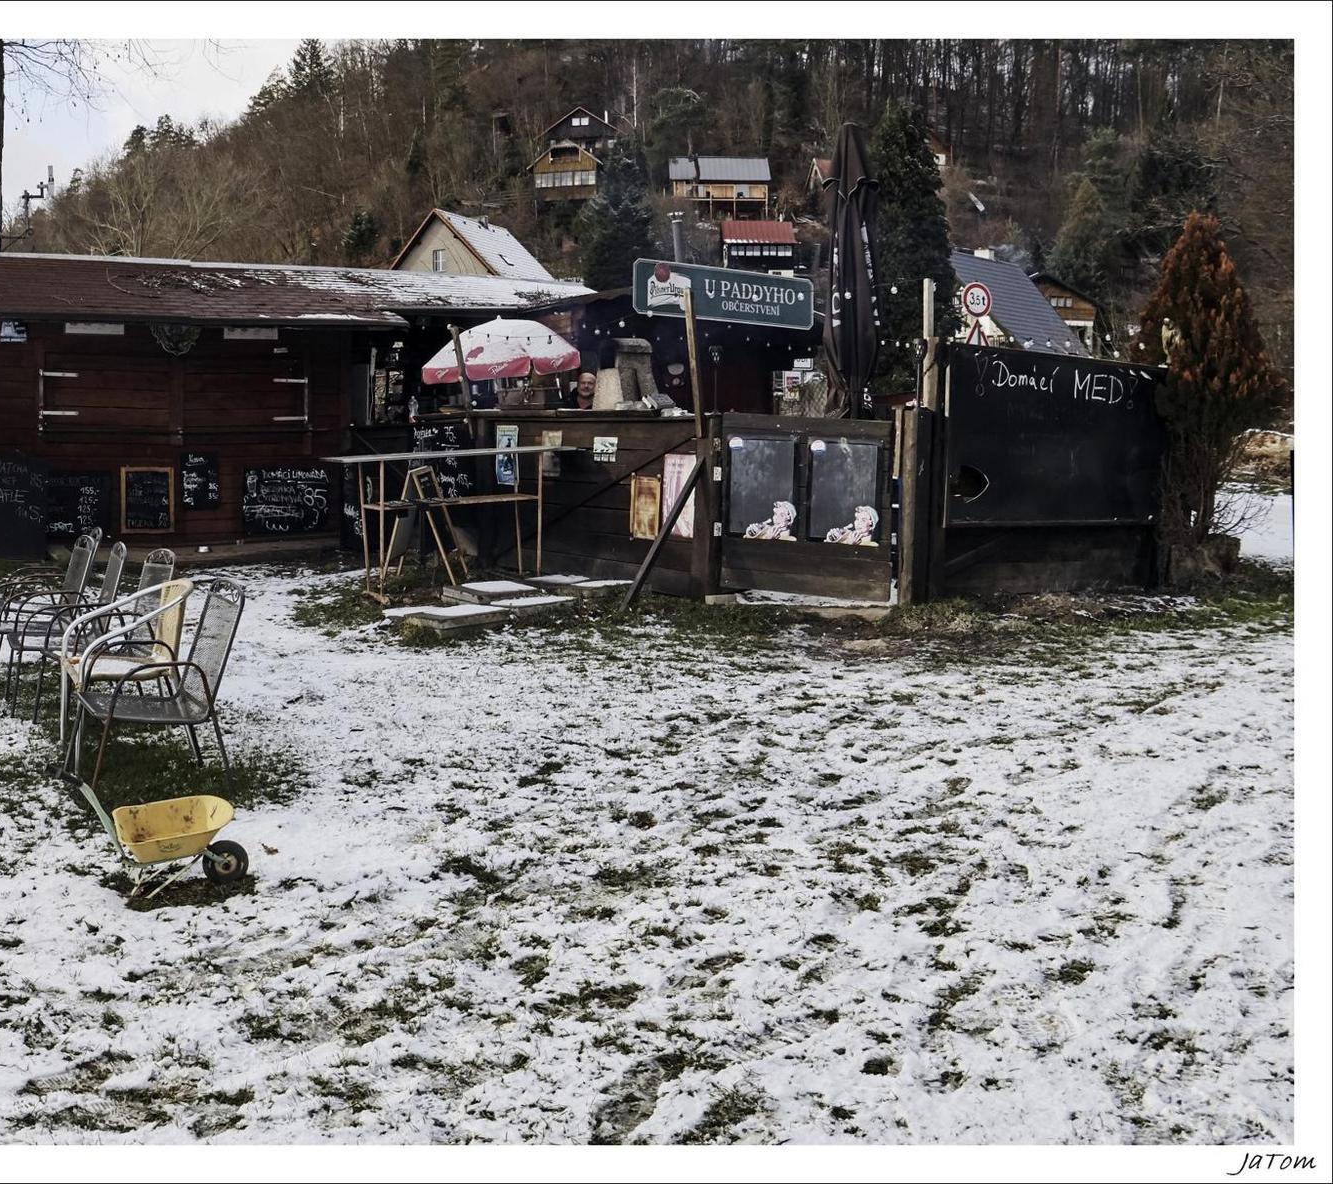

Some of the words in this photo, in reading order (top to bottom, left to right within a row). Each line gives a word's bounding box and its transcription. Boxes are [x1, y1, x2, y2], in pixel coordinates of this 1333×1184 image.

[704, 278, 716, 298] U
[719, 280, 797, 306] PADDYHO
[721, 300, 781, 316] OBČERSTVENÍ
